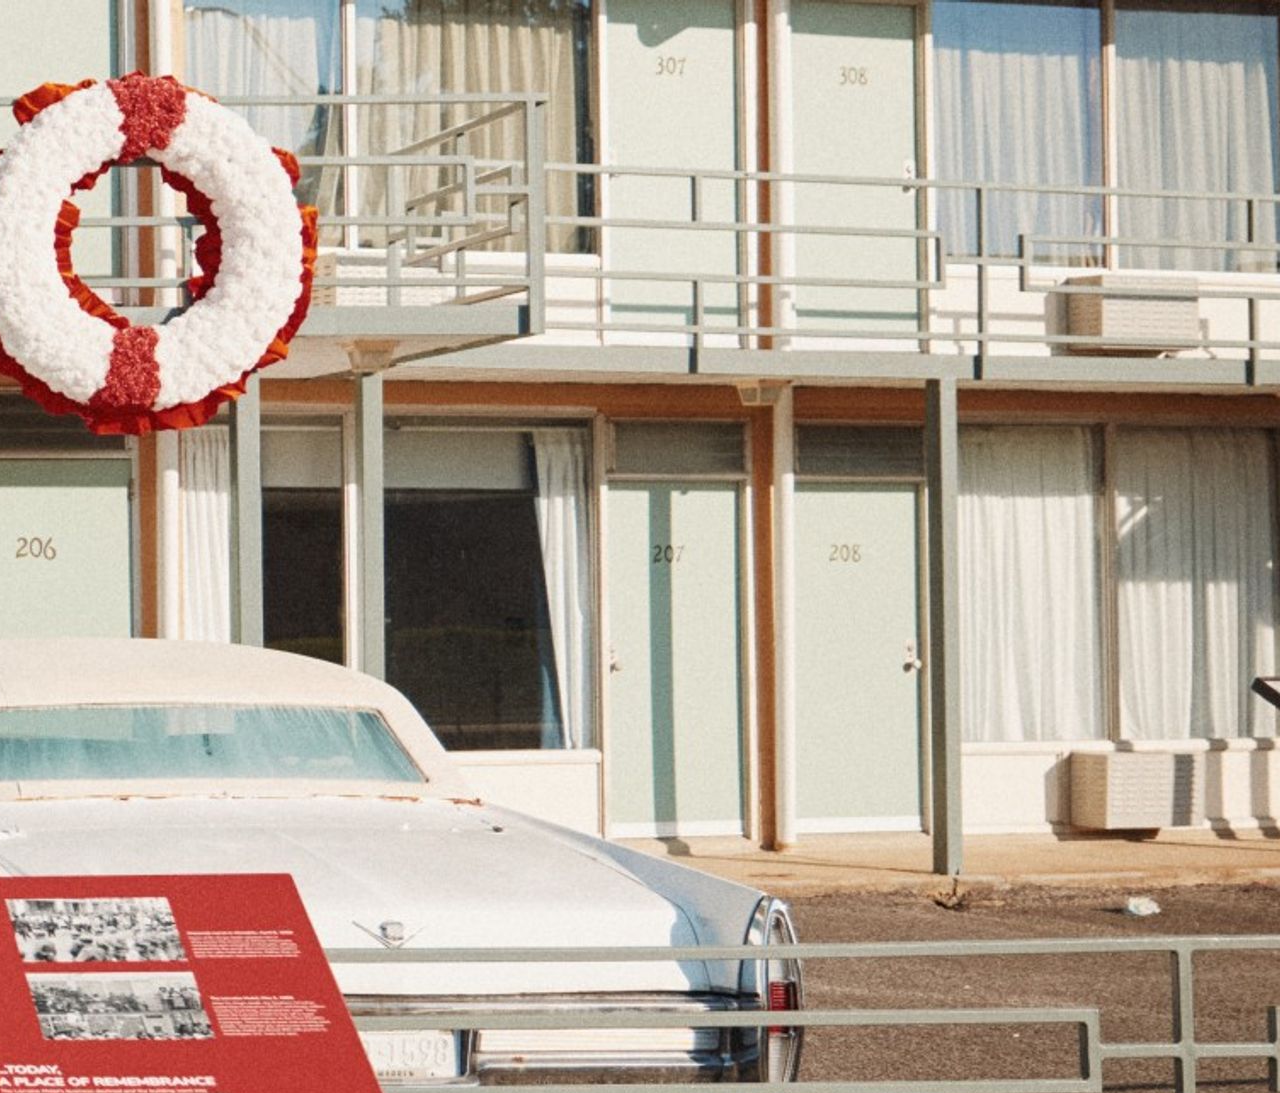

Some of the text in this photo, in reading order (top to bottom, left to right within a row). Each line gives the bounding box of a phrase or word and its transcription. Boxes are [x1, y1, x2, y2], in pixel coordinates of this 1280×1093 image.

[655, 56, 686, 76] 307
[839, 66, 868, 86] 308
[15, 537, 56, 560] 206
[653, 544, 684, 563] 207
[829, 544, 861, 562] 208
[13, 1076, 66, 1087] PLACE
[67, 1076, 90, 1087] OF
[92, 1075, 217, 1087] REMEMBRANCE
